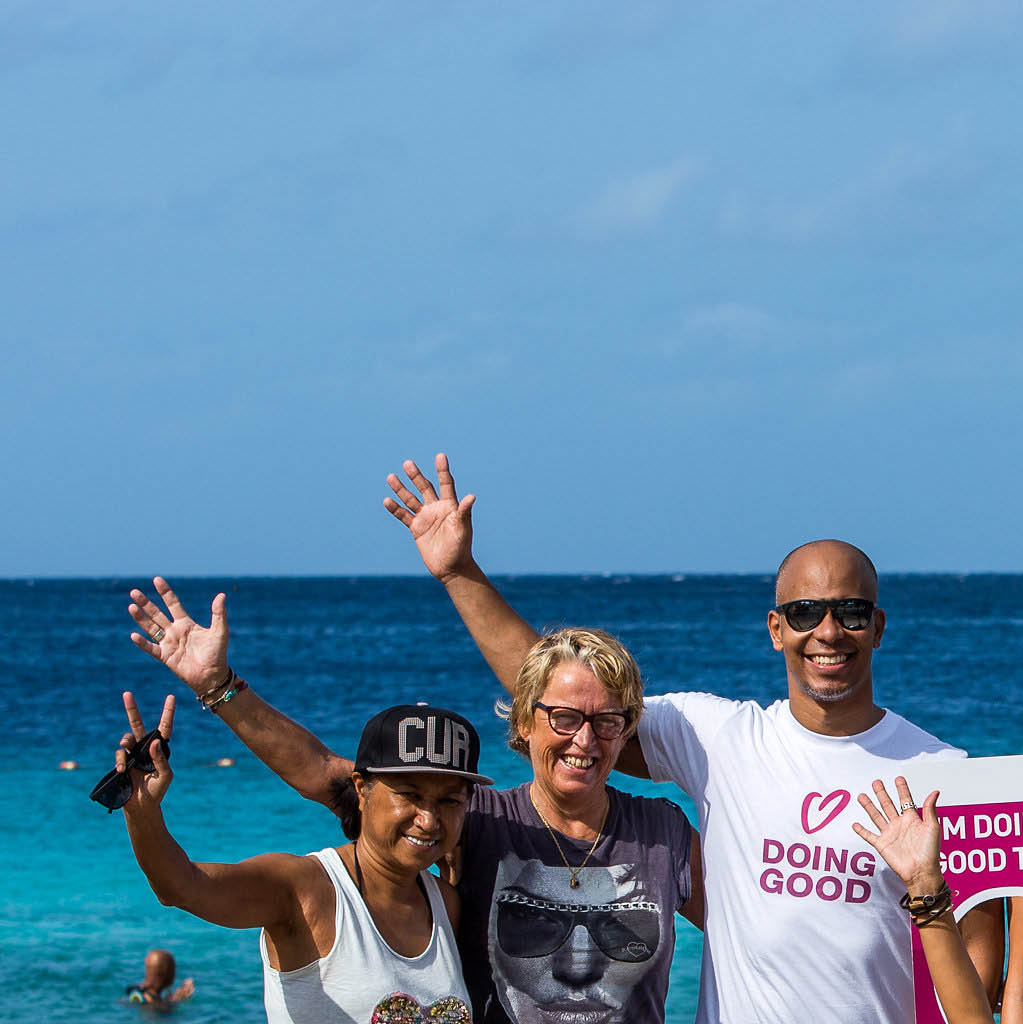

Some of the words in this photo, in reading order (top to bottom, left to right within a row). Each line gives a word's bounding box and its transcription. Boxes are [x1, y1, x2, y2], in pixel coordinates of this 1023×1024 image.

[398, 716, 470, 772] CUR
[762, 838, 876, 878] DOING
[759, 867, 872, 904] GOOD
